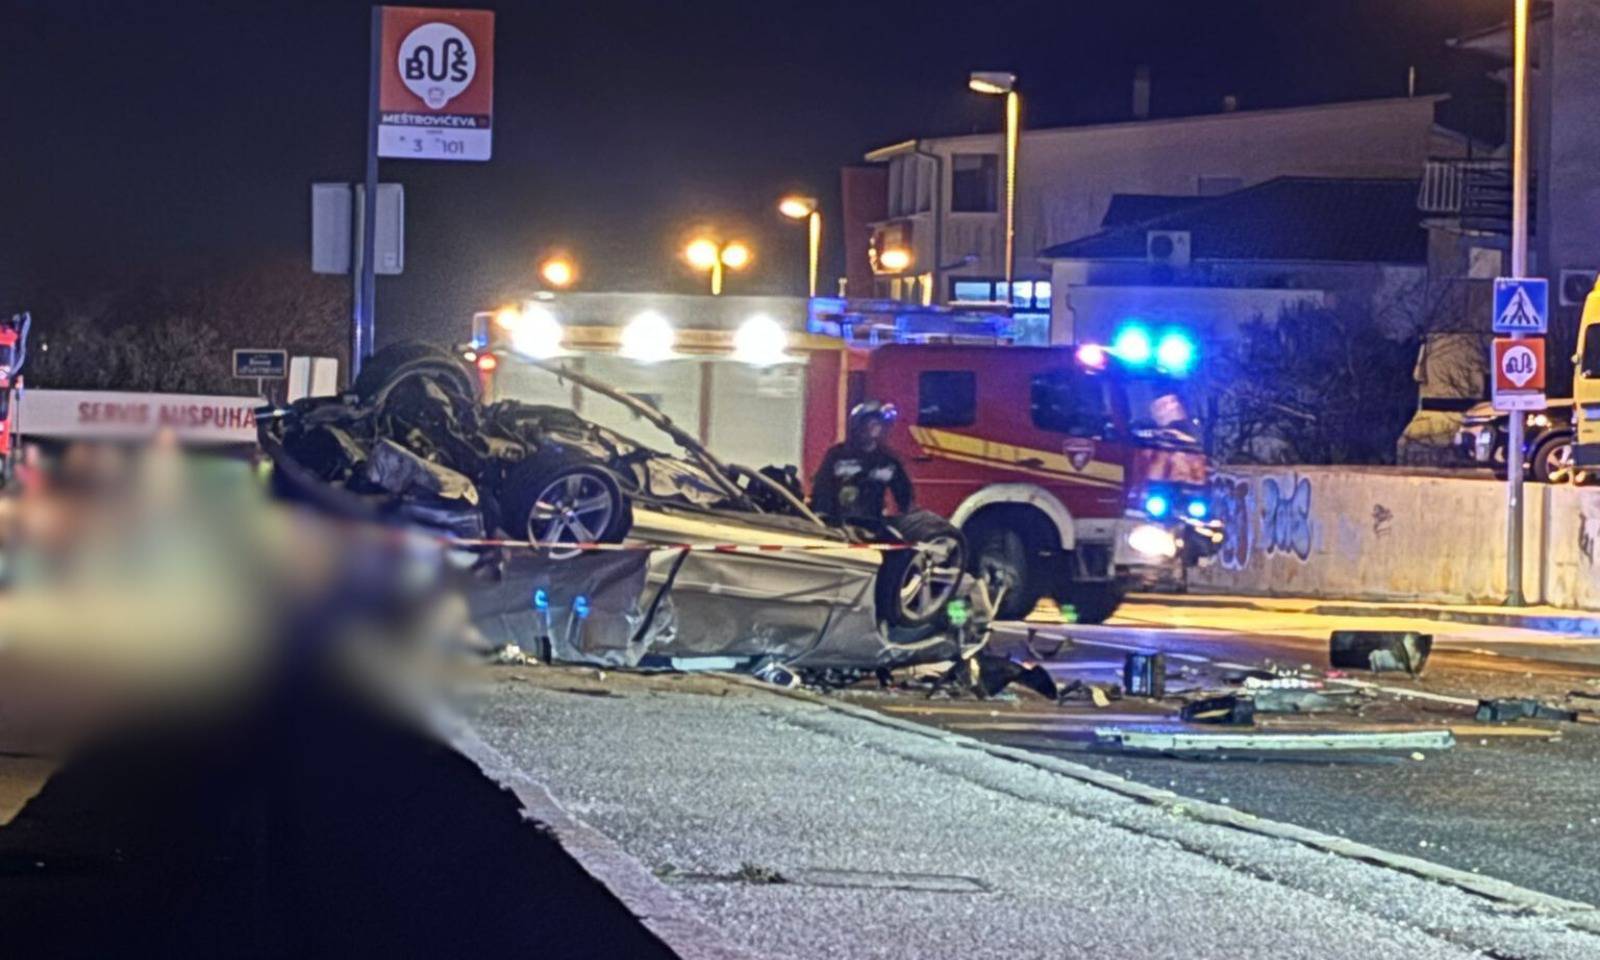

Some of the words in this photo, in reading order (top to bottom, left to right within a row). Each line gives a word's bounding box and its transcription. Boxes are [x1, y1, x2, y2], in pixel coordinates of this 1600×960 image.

[382, 113, 476, 127] MEŠTROVIĆEVA
[413, 139, 423, 153] 3
[442, 140, 464, 154] 101
[159, 405, 256, 429] AUSPUHA
